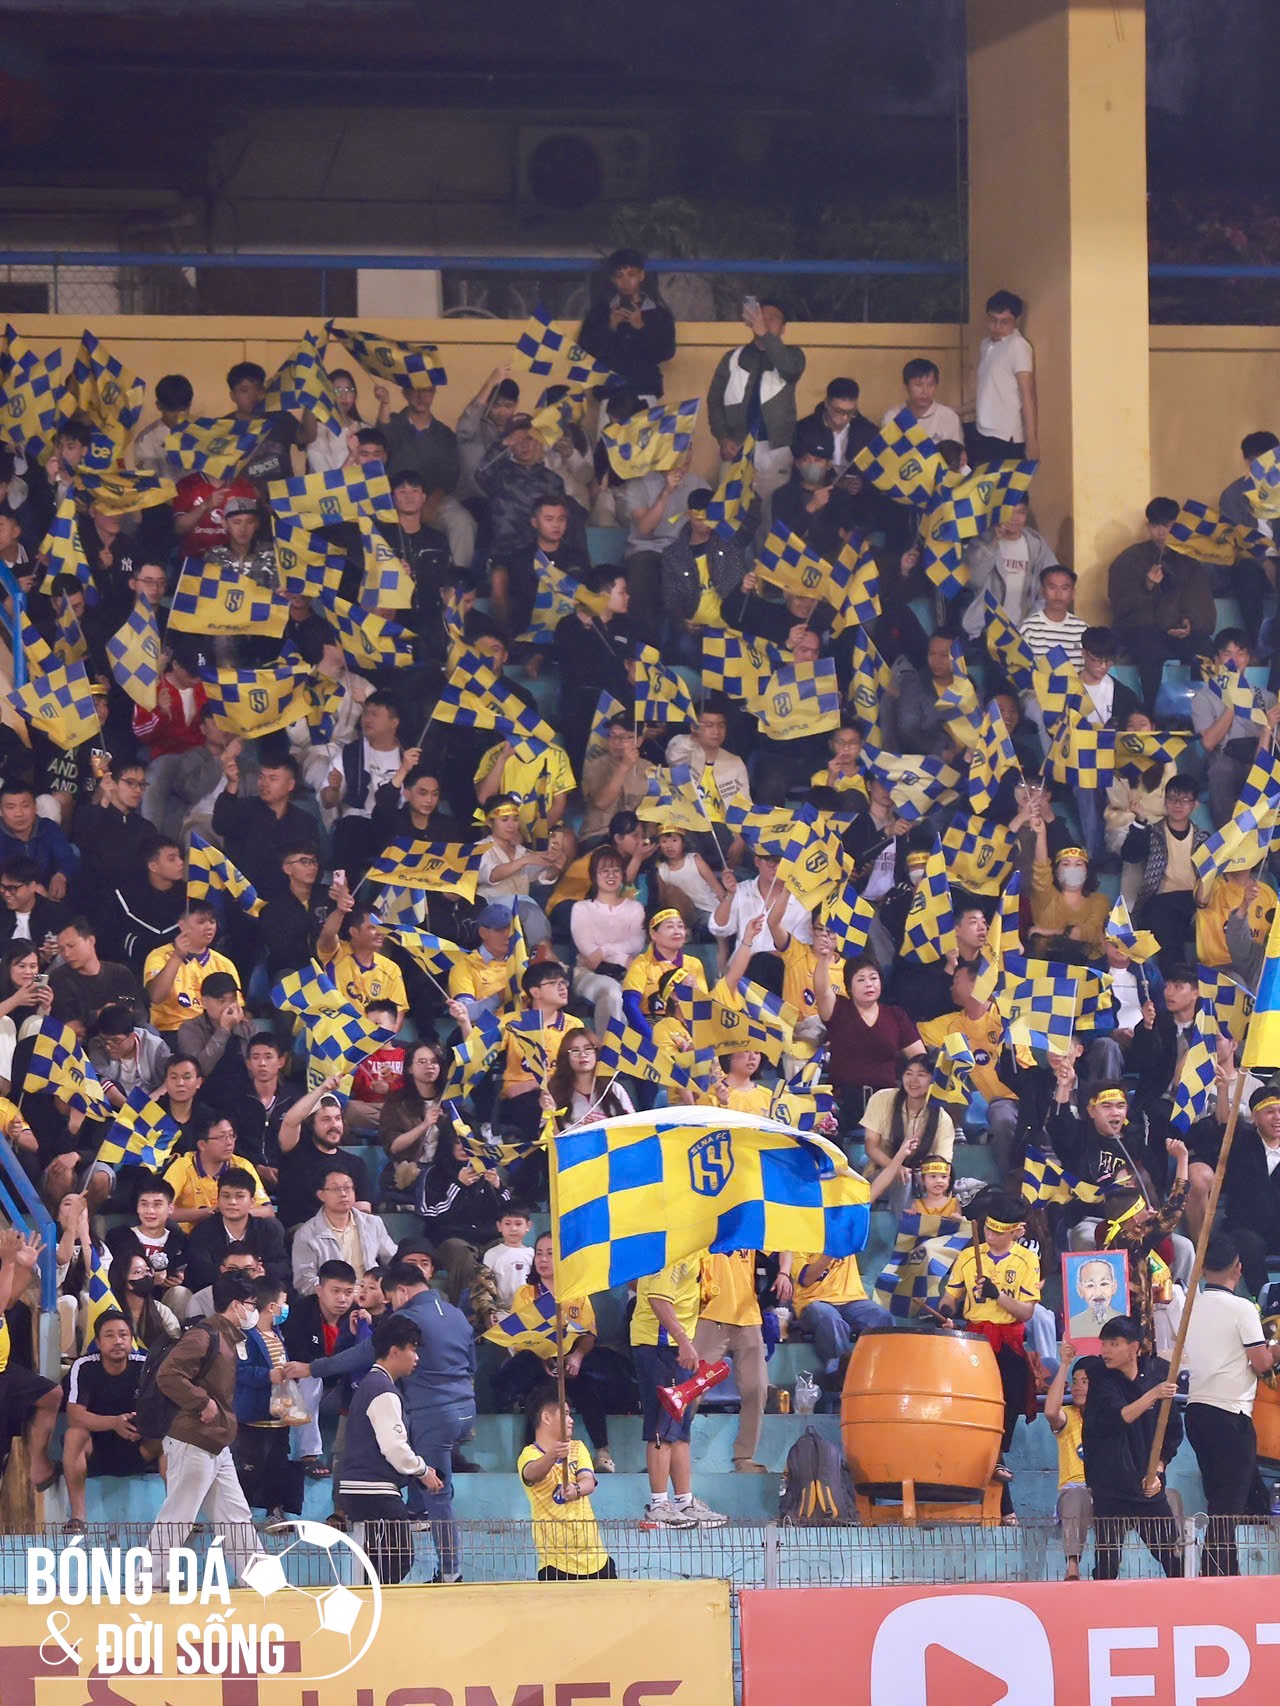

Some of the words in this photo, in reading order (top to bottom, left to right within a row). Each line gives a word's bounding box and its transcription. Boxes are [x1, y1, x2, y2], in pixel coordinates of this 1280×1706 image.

[91, 441, 112, 458] be
[48, 757, 78, 778] AND
[50, 778, 78, 794] AND
[690, 1136, 714, 1155] SLNA
[716, 1132, 727, 1140] FC
